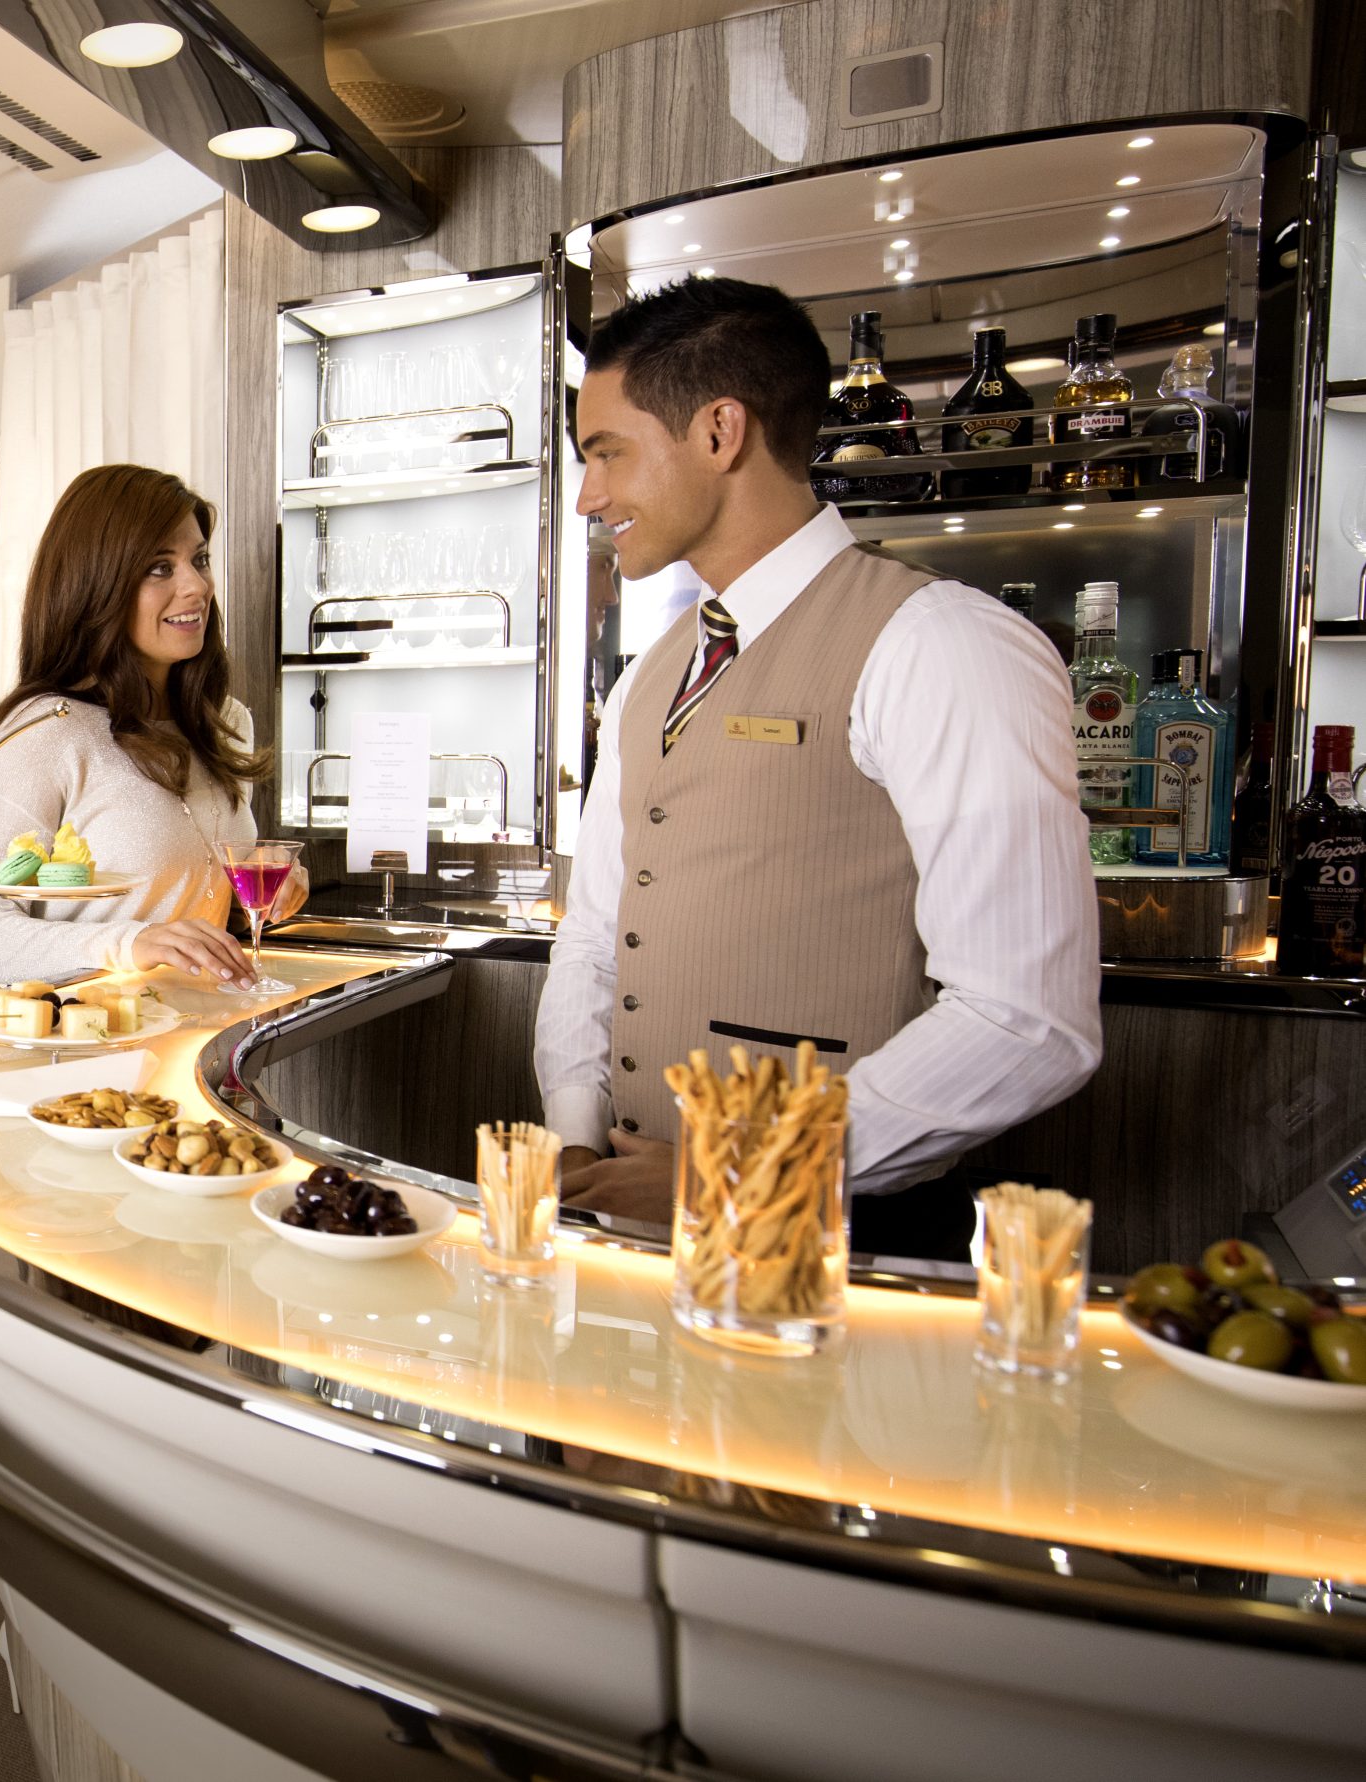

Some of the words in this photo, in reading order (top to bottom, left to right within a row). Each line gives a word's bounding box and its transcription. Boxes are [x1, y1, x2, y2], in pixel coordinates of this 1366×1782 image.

[967, 419, 1015, 431] BAILEYS
[1070, 417, 1123, 428] DRAMBUIE
[1165, 730, 1205, 744] BOMBAY
[1161, 773, 1203, 787] SAPPIRE
[1319, 865, 1356, 886] 20
